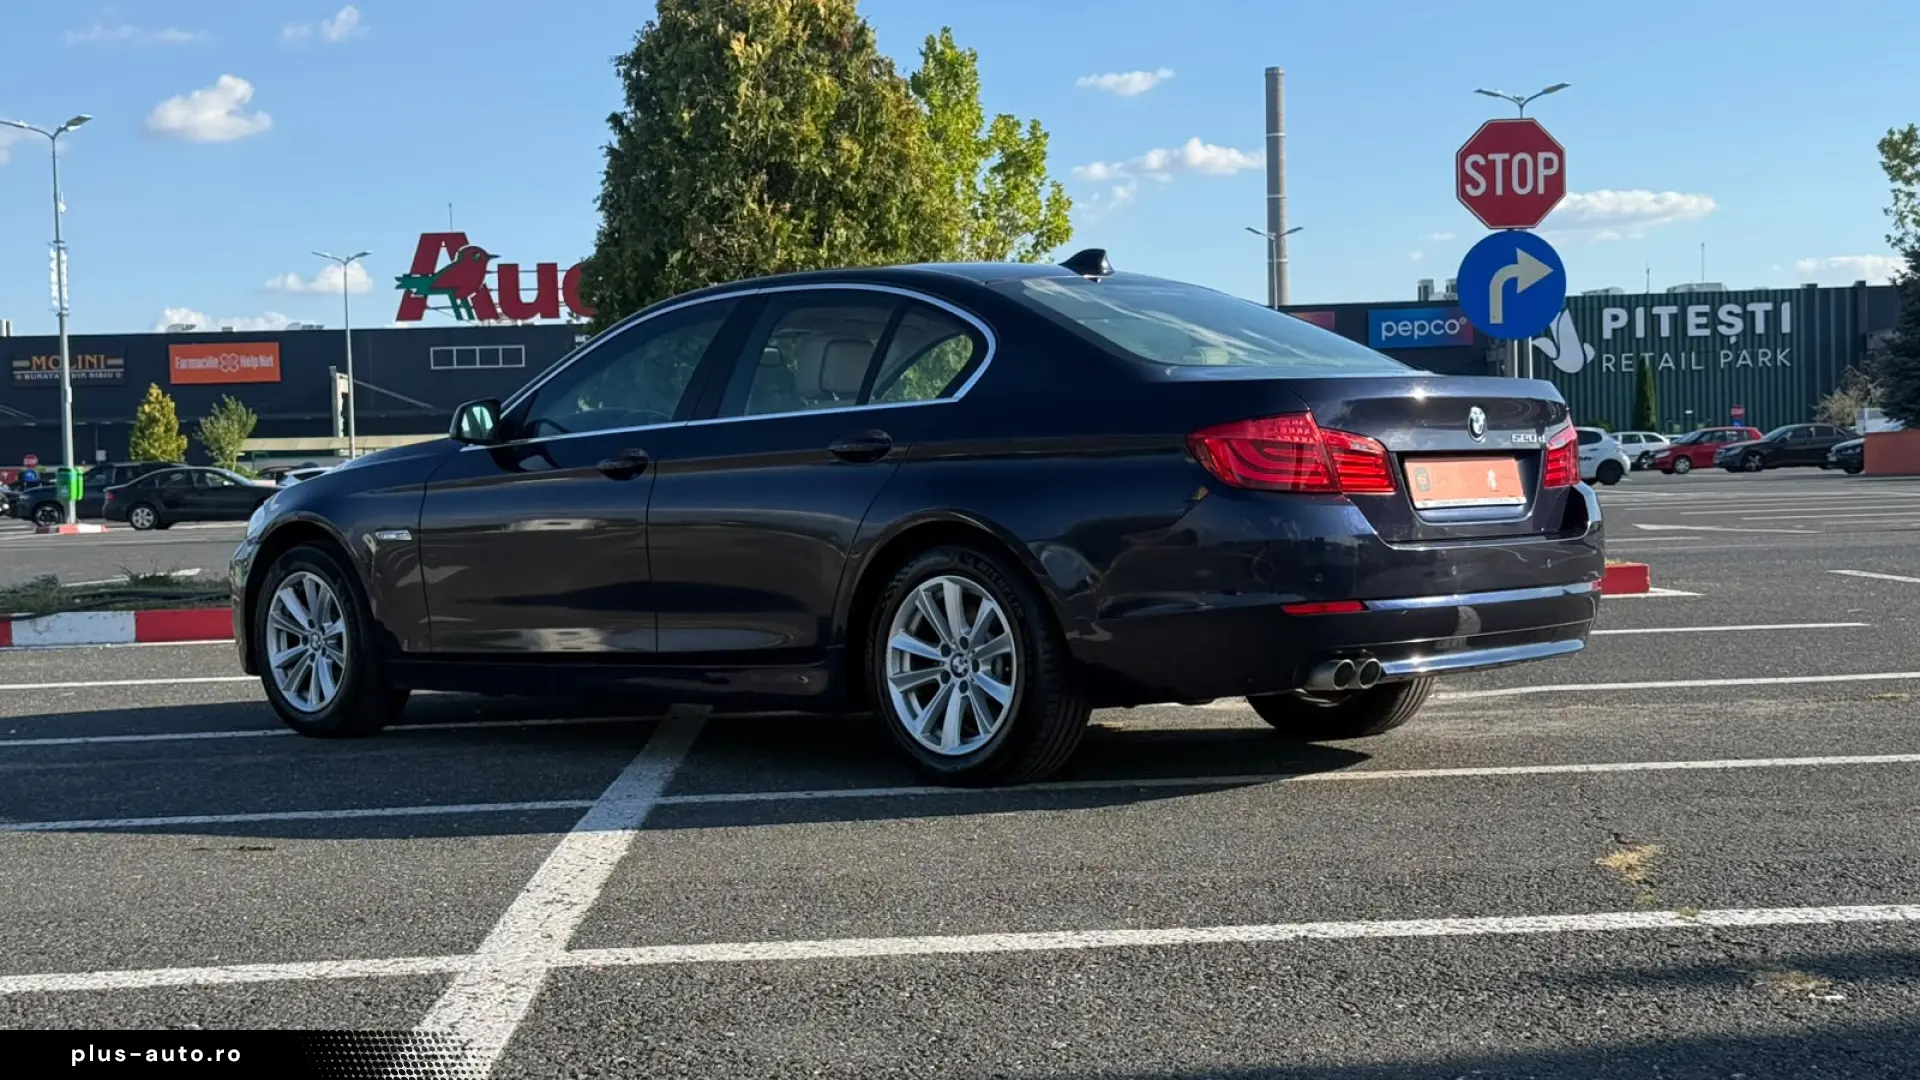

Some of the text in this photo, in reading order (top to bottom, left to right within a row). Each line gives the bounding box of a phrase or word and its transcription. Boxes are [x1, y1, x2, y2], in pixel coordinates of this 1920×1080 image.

[1464, 152, 1560, 197] STOP
[1602, 301, 1791, 344] PITEȘTI
[31, 354, 105, 371] MOINI
[1602, 348, 1791, 373] RETAIL PARK
